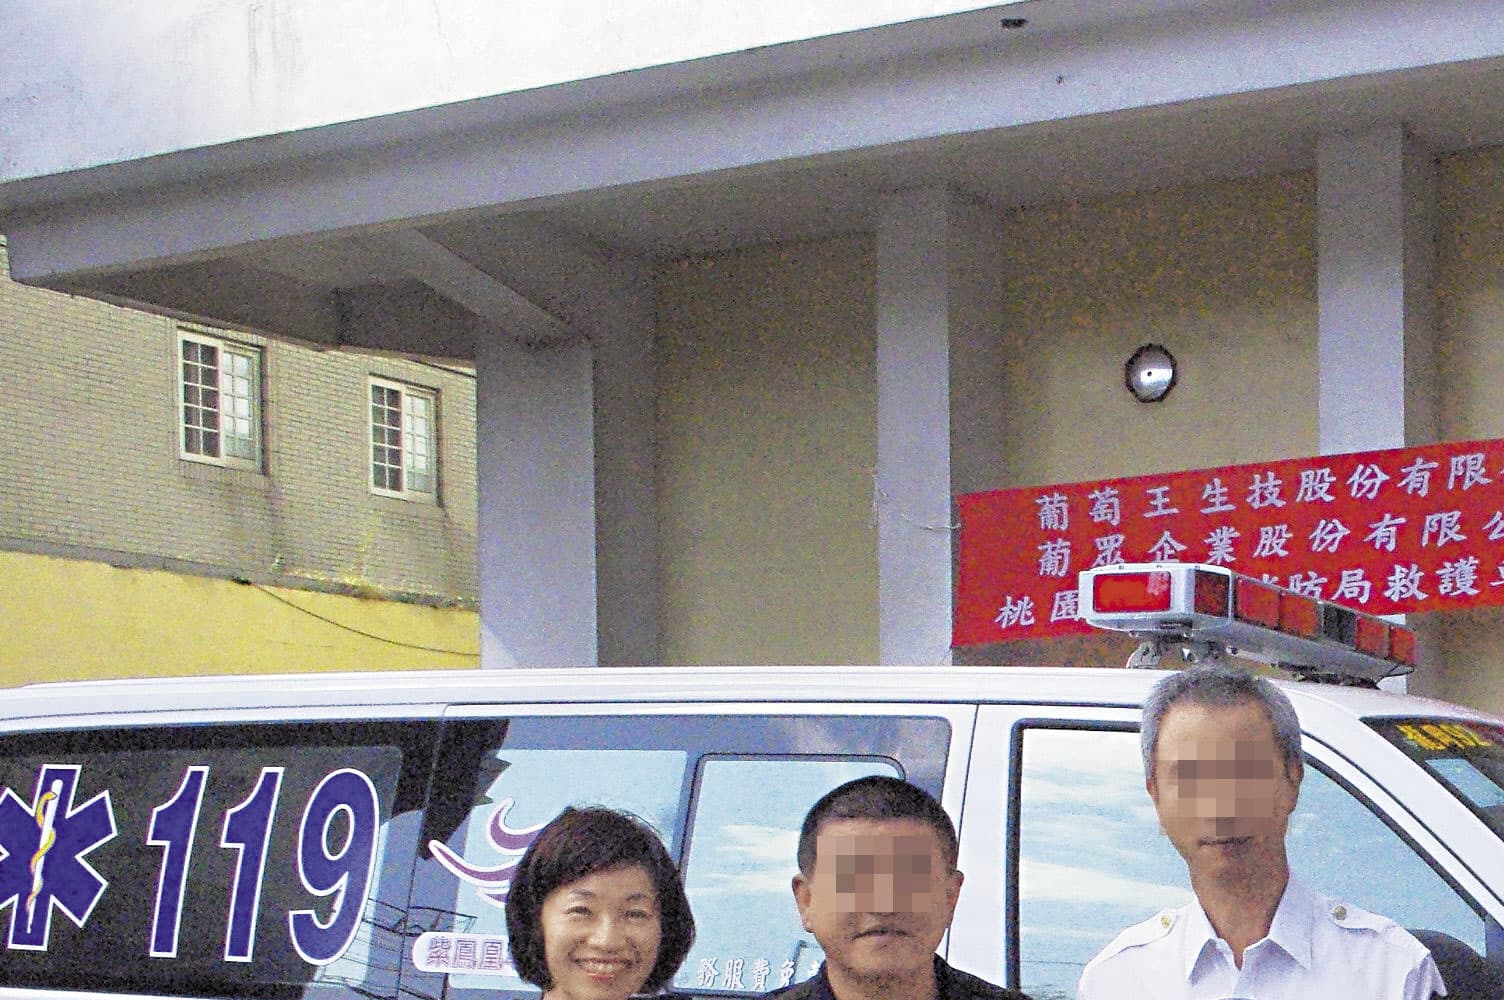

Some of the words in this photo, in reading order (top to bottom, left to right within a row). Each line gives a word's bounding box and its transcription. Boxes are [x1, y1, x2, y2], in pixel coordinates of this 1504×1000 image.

[146, 765, 381, 965] 119
[426, 935, 512, 971] 紫鳳凰
